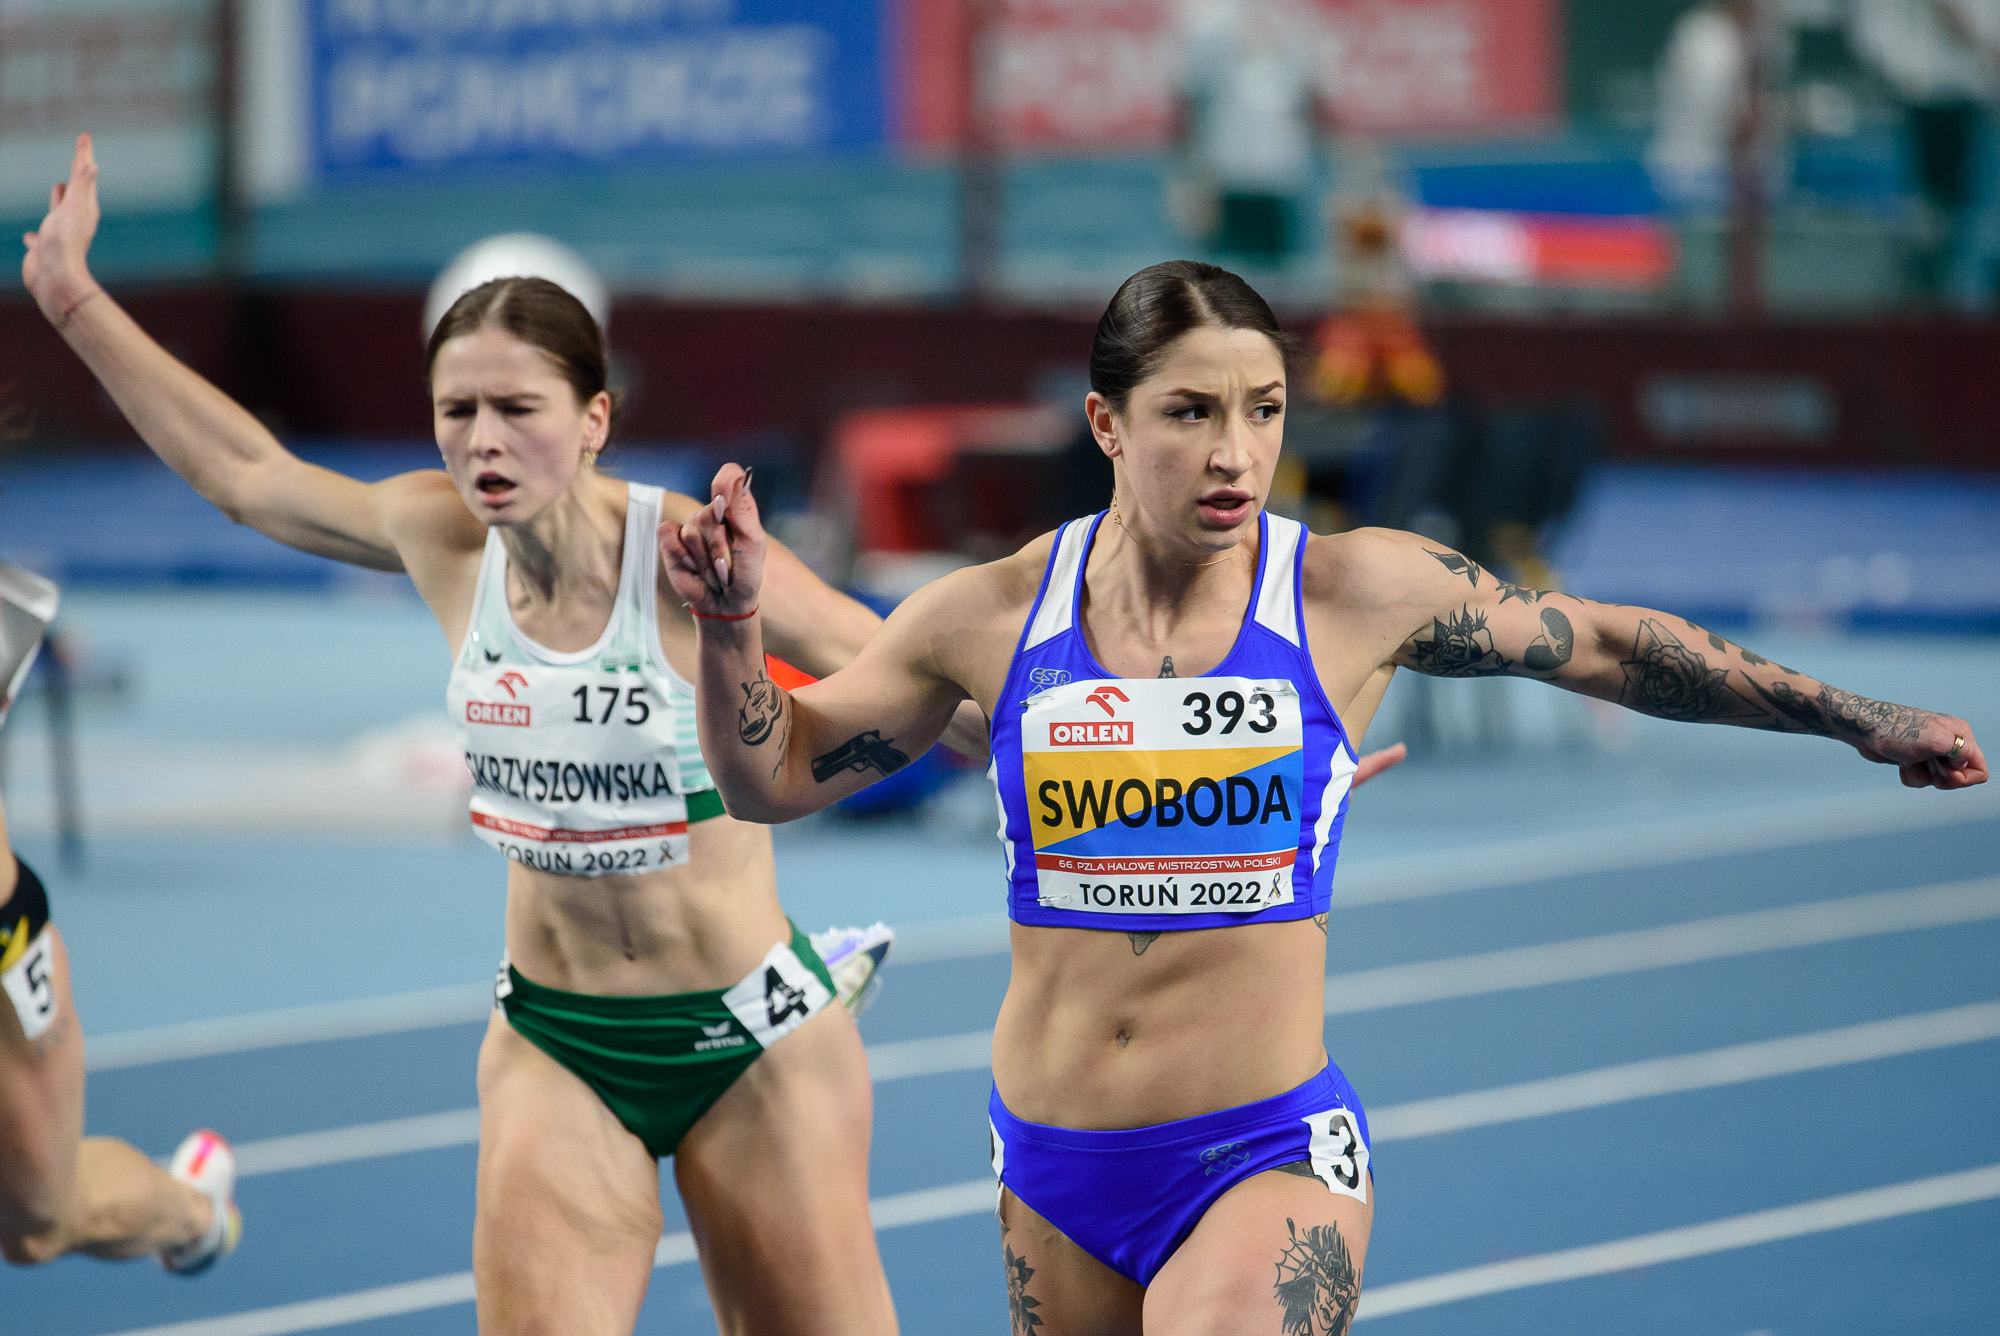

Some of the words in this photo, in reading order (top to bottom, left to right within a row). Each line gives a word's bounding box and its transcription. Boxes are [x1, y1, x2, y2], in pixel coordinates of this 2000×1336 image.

[467, 704, 528, 724] ORLEN
[572, 685, 650, 725] 175
[1182, 691, 1278, 736] 393
[1053, 724, 1129, 743] ORLEN
[1038, 775, 1292, 829] SWOBODA
[582, 849, 647, 871] 2022
[1058, 859, 1076, 869] 66.
[1077, 862, 1106, 872] PZLA
[1107, 860, 1155, 871] HALOWE
[1157, 859, 1242, 870] MISTRZOSTWA
[1244, 856, 1281, 868] POLSKI
[1079, 877, 1178, 907] TORUŃ
[1189, 881, 1262, 906] 2022
[26, 951, 54, 1015] 5
[765, 965, 809, 1027] 4
[1329, 1115, 1359, 1190] 3
